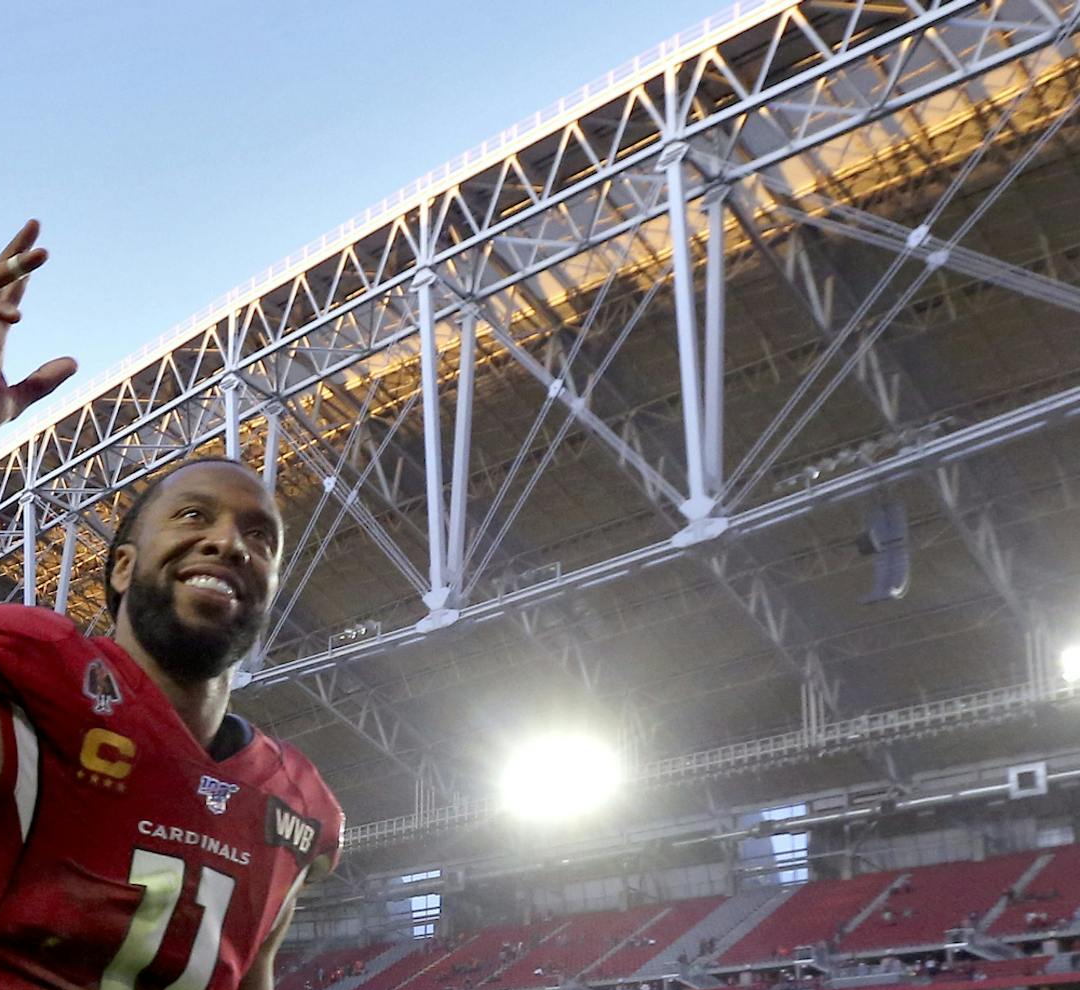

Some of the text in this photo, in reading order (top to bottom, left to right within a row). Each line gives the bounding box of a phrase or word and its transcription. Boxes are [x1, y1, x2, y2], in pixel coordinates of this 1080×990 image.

[80, 727, 136, 779] C
[138, 820, 251, 866] CARDINALS
[275, 808, 316, 853] WVB
